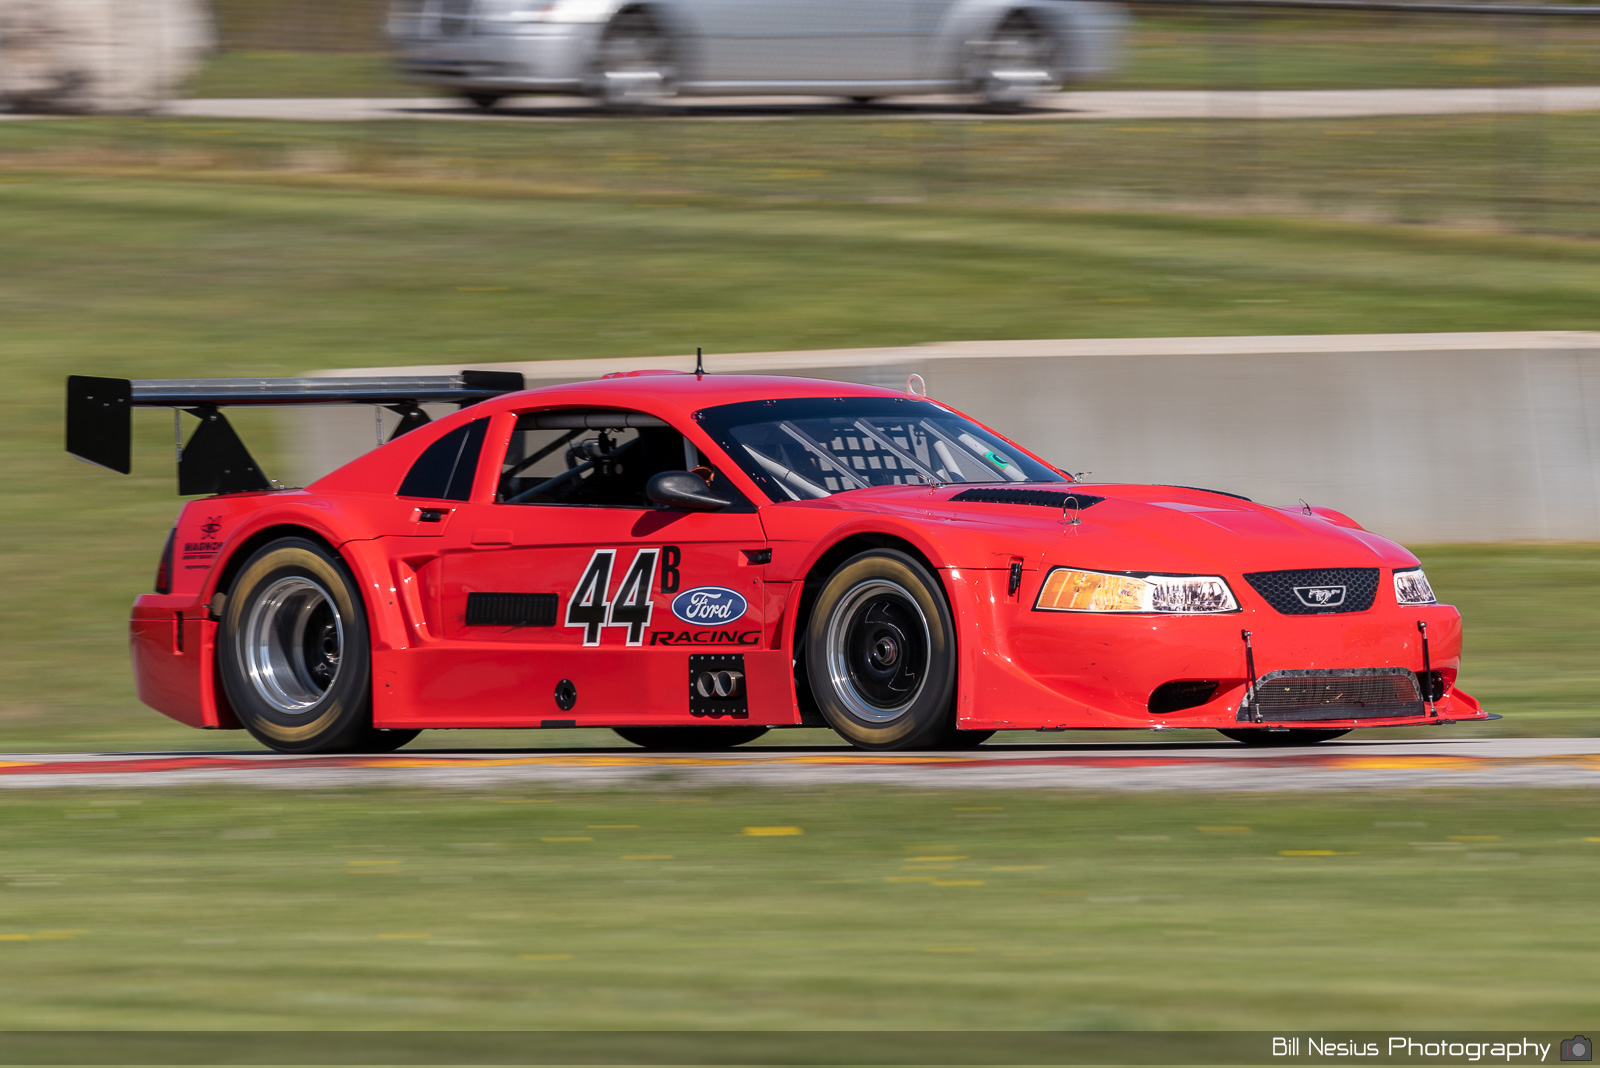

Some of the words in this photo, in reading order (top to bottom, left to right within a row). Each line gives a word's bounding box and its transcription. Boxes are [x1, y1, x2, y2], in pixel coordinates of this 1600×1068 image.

[564, 548, 660, 647] 44
[660, 545, 681, 594] B
[686, 591, 733, 618] Ford
[649, 630, 762, 646] RACING
